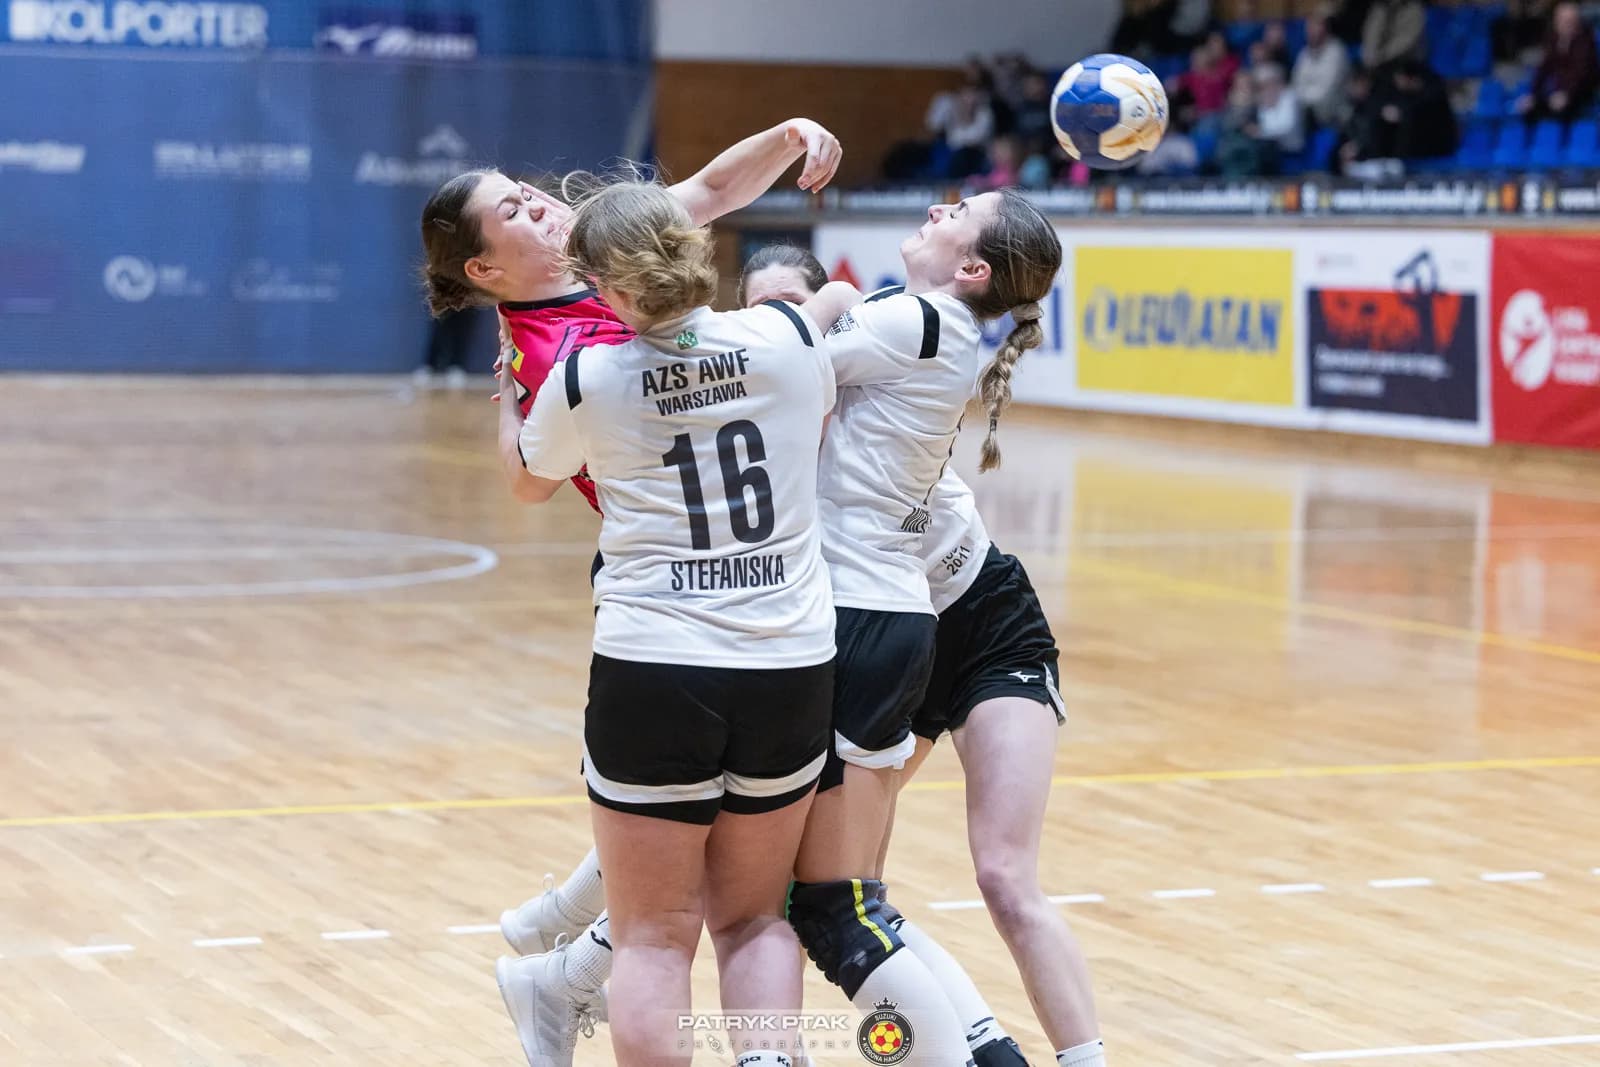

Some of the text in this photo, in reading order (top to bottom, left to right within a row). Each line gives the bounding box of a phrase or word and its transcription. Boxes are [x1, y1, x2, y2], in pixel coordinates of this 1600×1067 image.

[642, 348, 749, 397] AZS AWF
[656, 381, 747, 416] WARSZAWA
[662, 419, 775, 550] 16
[946, 545, 971, 576] 2011
